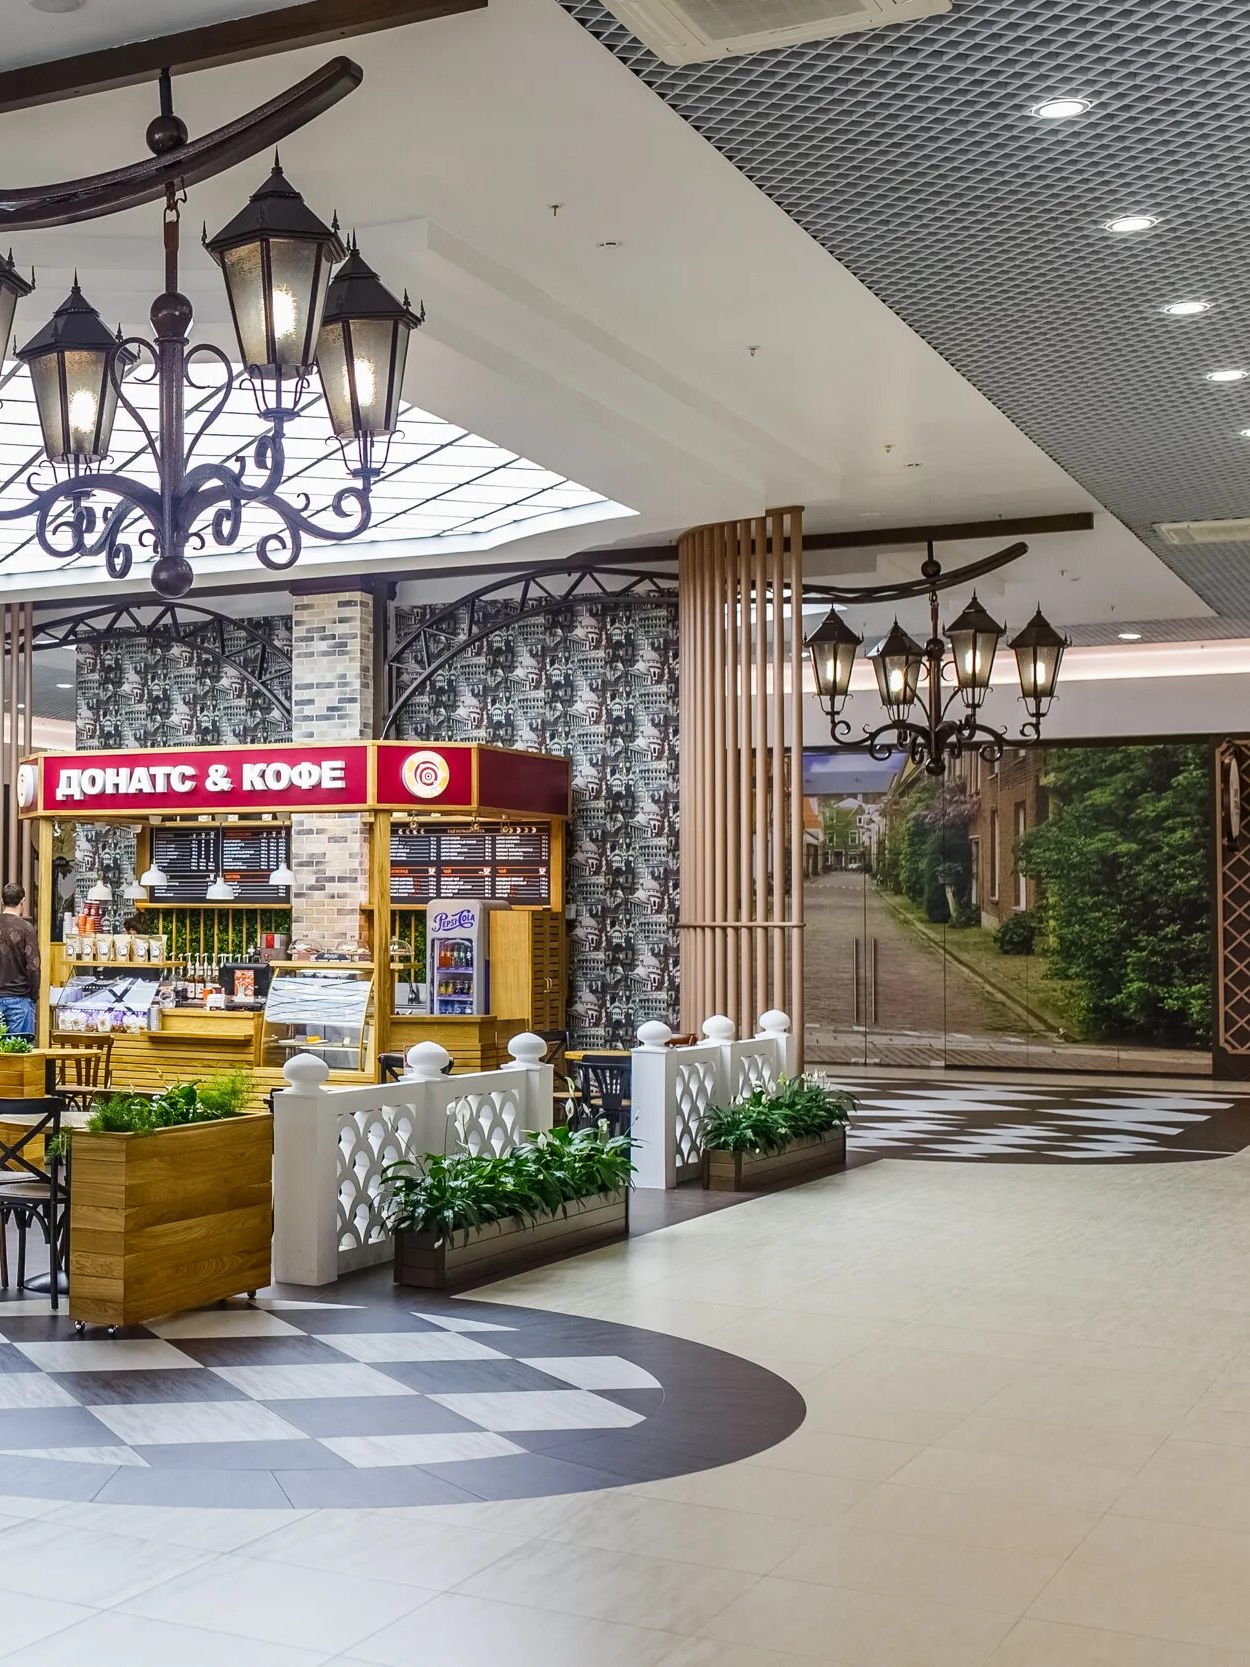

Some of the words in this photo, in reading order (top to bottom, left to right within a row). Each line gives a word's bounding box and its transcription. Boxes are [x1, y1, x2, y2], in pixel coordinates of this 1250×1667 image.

[55, 765, 197, 800] ДОНАТС
[205, 764, 234, 792] &
[242, 760, 346, 791] КОФЕ
